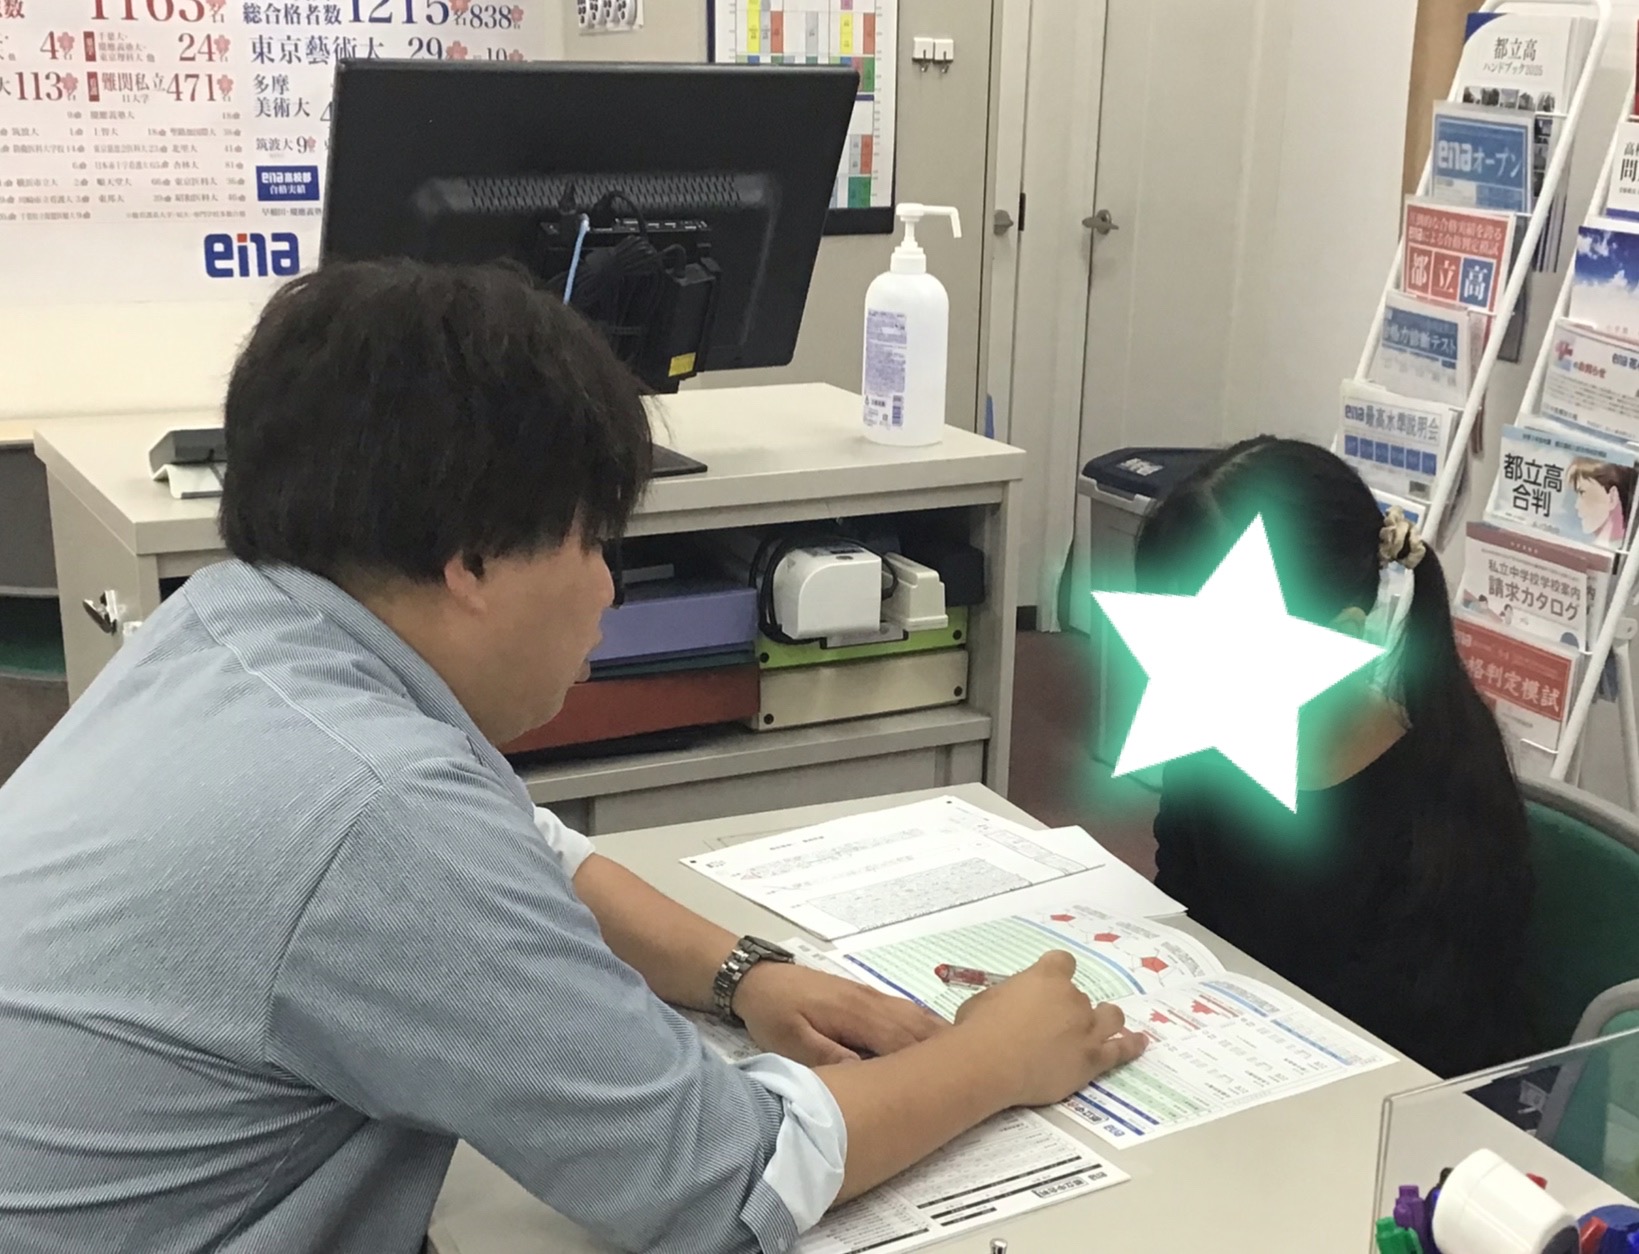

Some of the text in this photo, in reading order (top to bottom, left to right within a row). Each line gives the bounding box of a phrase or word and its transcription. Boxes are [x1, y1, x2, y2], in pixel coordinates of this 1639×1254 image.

[243, 3, 342, 25] 総合格者数
[349, 0, 449, 25] 1215
[470, 4, 512, 29] 838
[40, 31, 59, 61] 4
[178, 33, 217, 62] 24
[1494, 37, 1538, 62] 都立高
[15, 72, 62, 101] 113
[102, 72, 167, 92] 難関私立
[166, 73, 217, 102] 471
[253, 74, 290, 95] 多摩
[255, 97, 311, 118] 美術大
[256, 137, 307, 154] 筑波大 9
[1438, 140, 1522, 178] enaオープン
[204, 232, 301, 278] ena
[1411, 252, 1488, 301] 都立高
[1345, 404, 1439, 442] ena最高水準説明会
[1503, 452, 1565, 494] 都立高
[1512, 484, 1552, 518] 合判
[1488, 559, 1581, 601] 私立中学校学校案内
[1488, 574, 1580, 621] 請求カタログ
[1466, 656, 1560, 713] 格判定模試
